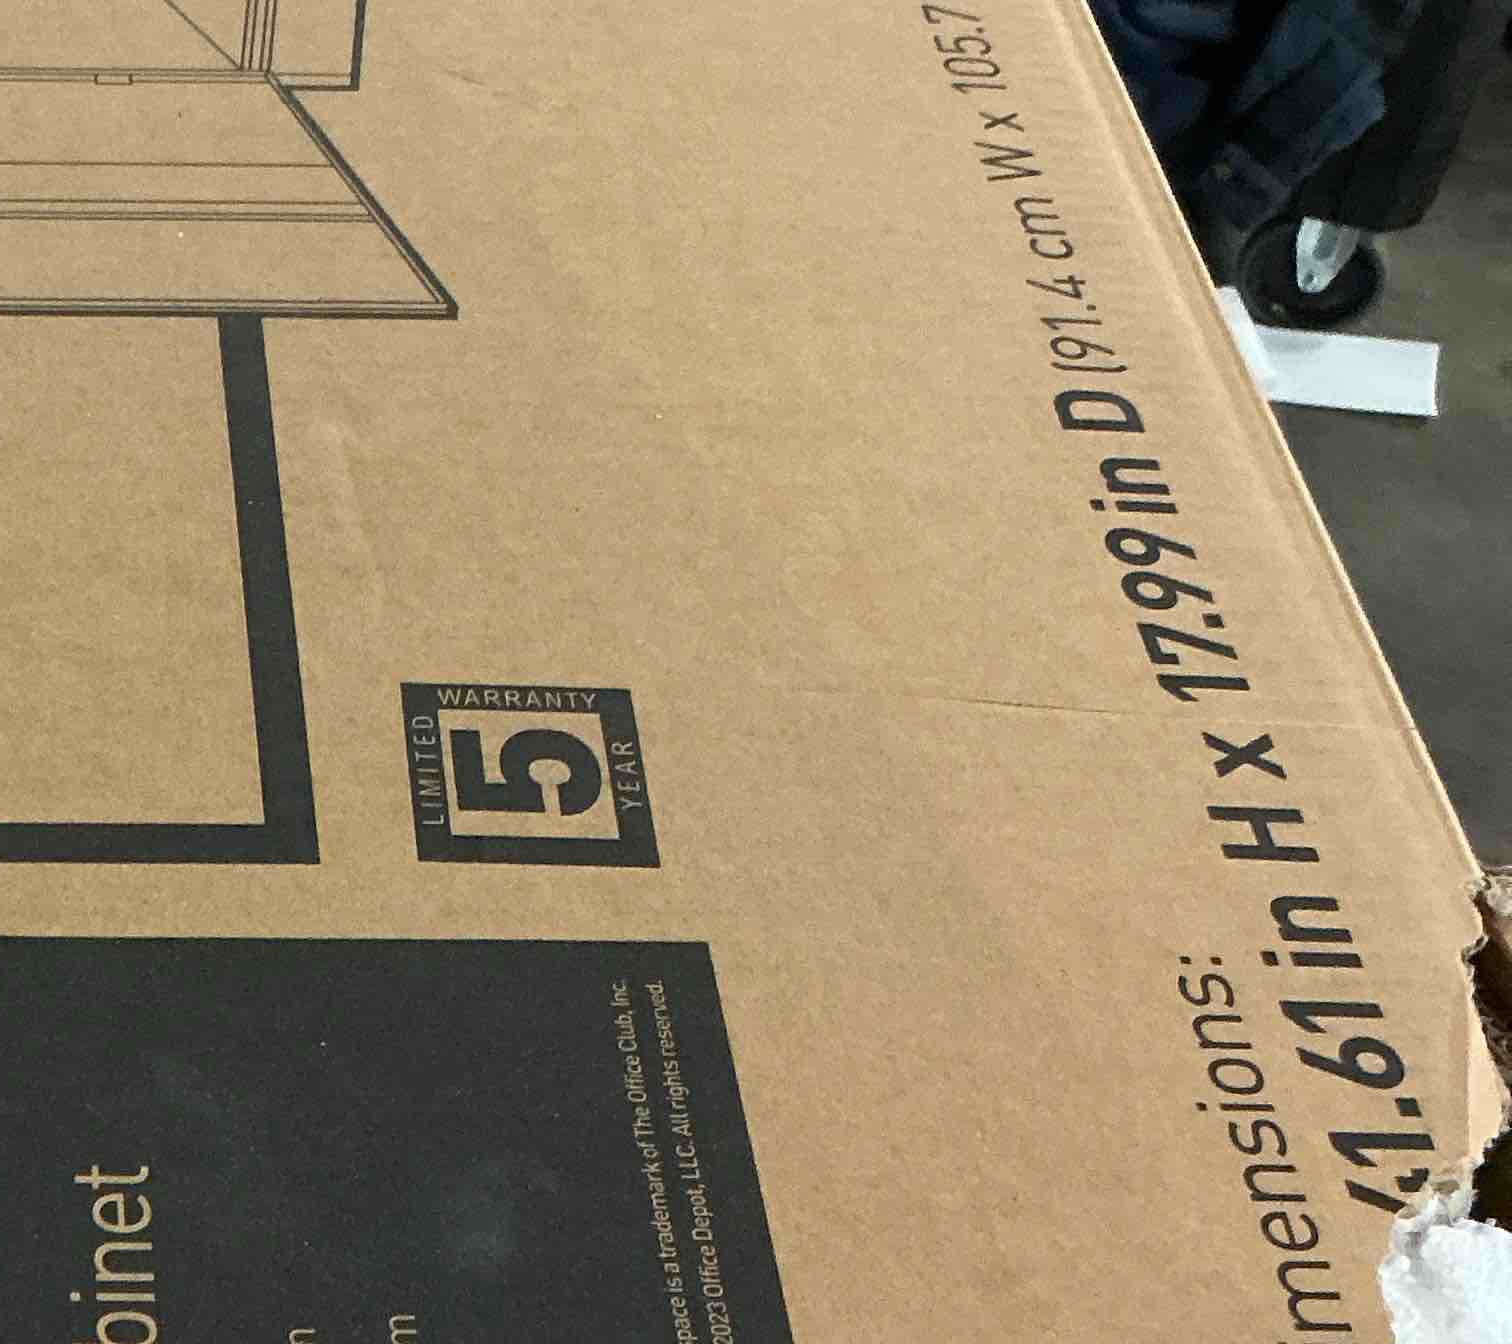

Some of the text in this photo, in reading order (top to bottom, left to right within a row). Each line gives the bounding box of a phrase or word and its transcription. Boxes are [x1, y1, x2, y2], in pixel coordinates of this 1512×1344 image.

[921, 2, 1008, 95] 105.7
[978, 111, 1025, 132] x
[973, 141, 1043, 182] W
[1014, 197, 1074, 260] cm
[1053, 389, 1145, 434] D
[438, 688, 599, 709] WARRANTY
[412, 715, 444, 825] LIMITED
[450, 728, 602, 816] 5
[611, 741, 642, 812] YEAR
[1202, 732, 1287, 780] x
[1207, 806, 1320, 862] H
[1260, 896, 1364, 968] in
[614, 1010, 638, 1053] Club,
[644, 979, 677, 1056] reserved.
[624, 1055, 648, 1103] Office
[663, 1060, 689, 1108] rights
[632, 1107, 656, 1138] The
[669, 1113, 693, 1137] All
[637, 1140, 659, 1159] of
[675, 1140, 700, 1180] LLC.
[641, 1162, 677, 1259] trademark
[686, 1183, 714, 1241] Depot,
[664, 1263, 680, 1274] a
[665, 1277, 683, 1294] is
[698, 1245, 724, 1298] Office
